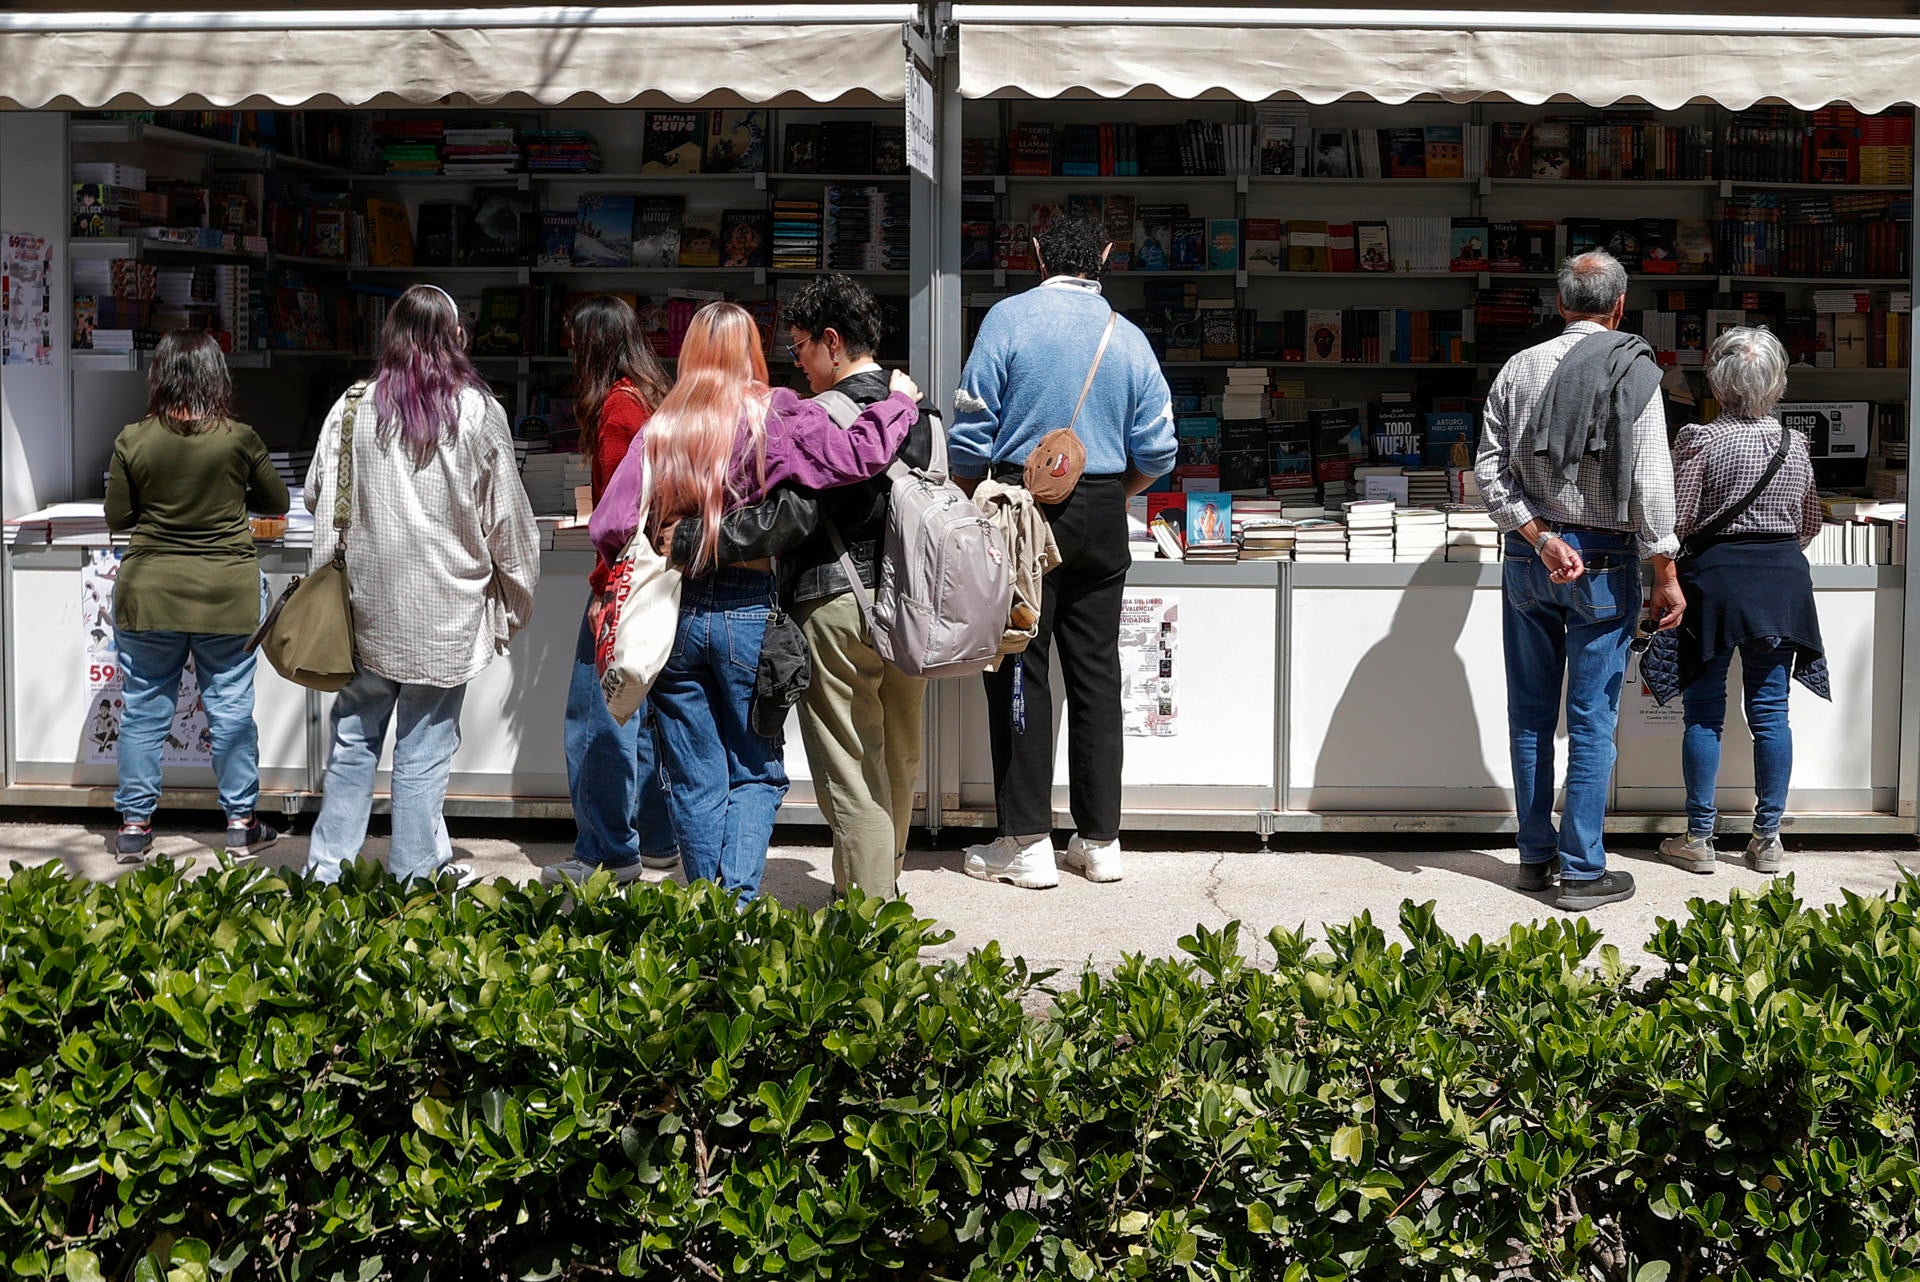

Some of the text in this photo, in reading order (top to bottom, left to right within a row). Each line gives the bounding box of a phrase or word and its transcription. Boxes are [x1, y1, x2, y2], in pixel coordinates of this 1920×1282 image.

[651, 121, 696, 132] GRUPO
[1436, 418, 1464, 426] ARTURO
[1786, 415, 1816, 425] BONO
[1384, 421, 1412, 436] TODO
[1376, 435, 1421, 456] VUELVE
[89, 665, 115, 682] 59
